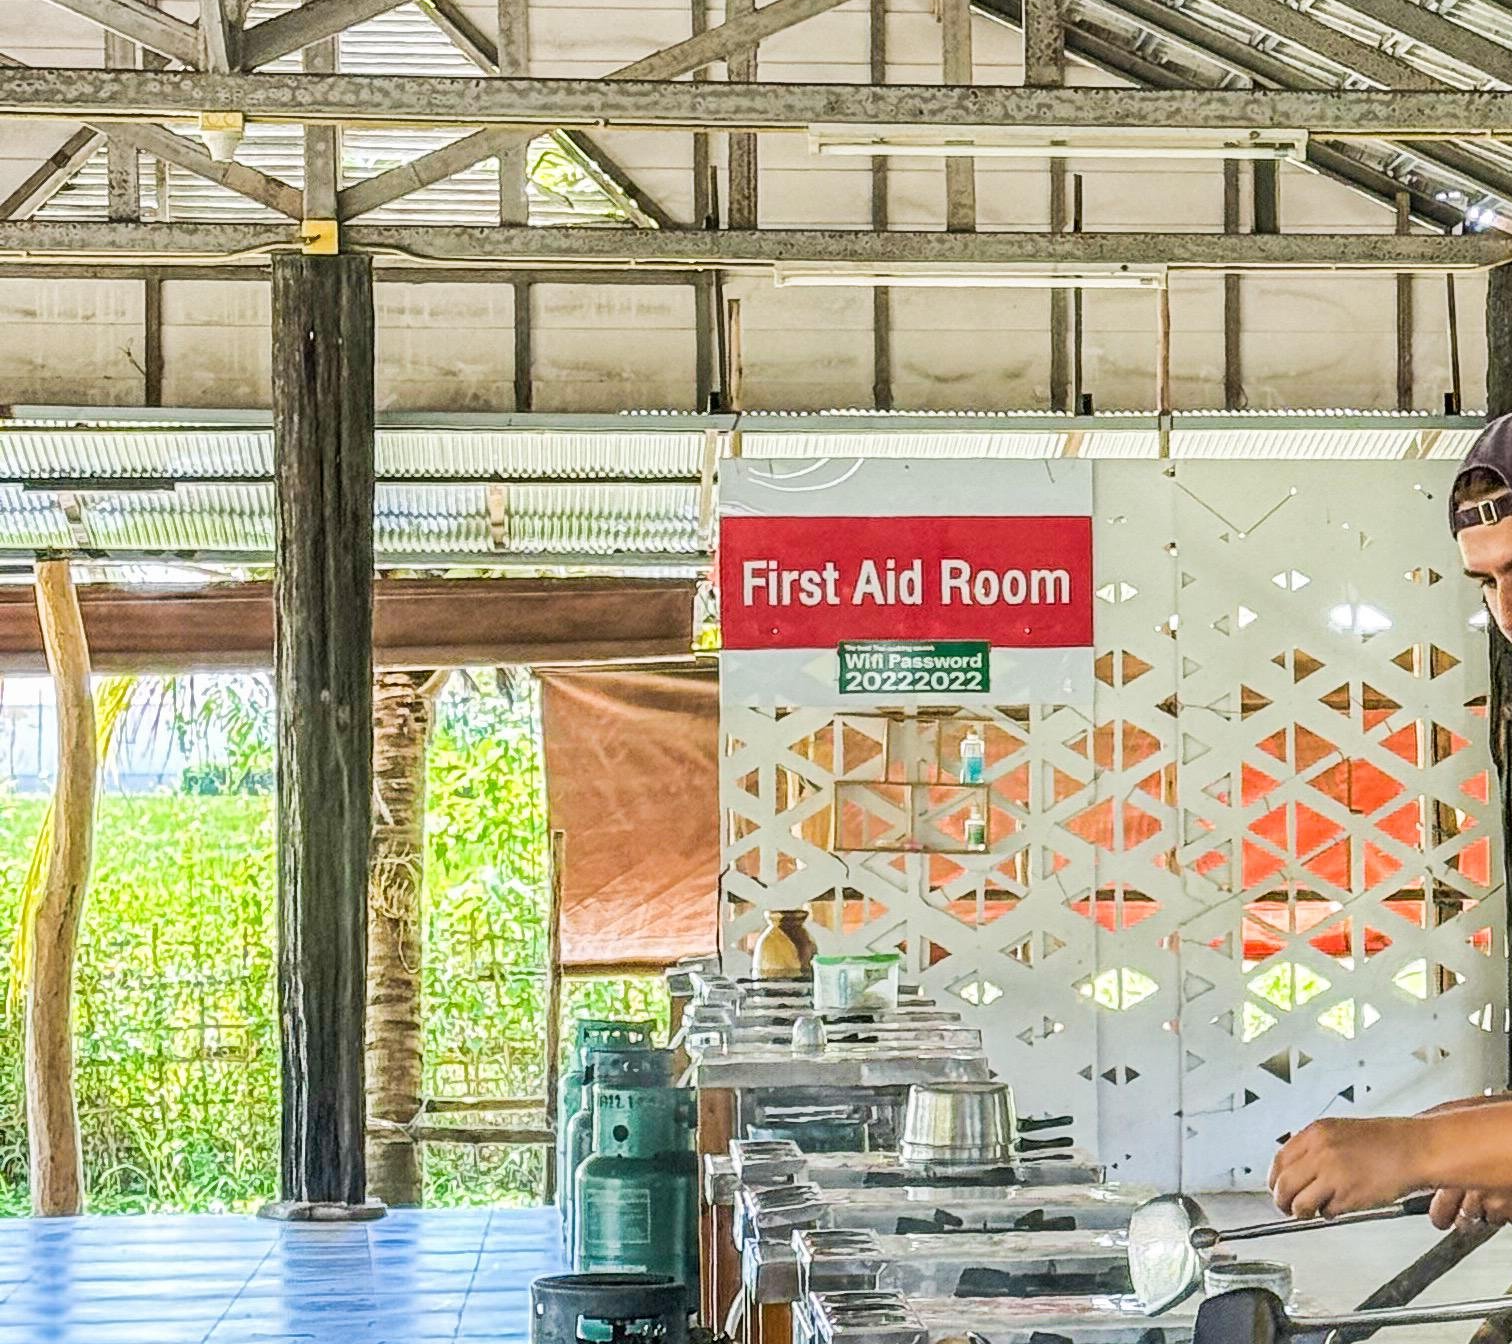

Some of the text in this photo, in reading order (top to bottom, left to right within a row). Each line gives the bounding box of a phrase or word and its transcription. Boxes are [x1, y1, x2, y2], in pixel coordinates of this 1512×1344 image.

[743, 559, 1071, 607] First Aid Room
[845, 652, 982, 669] Wifi Password
[845, 671, 983, 691] 20222022
